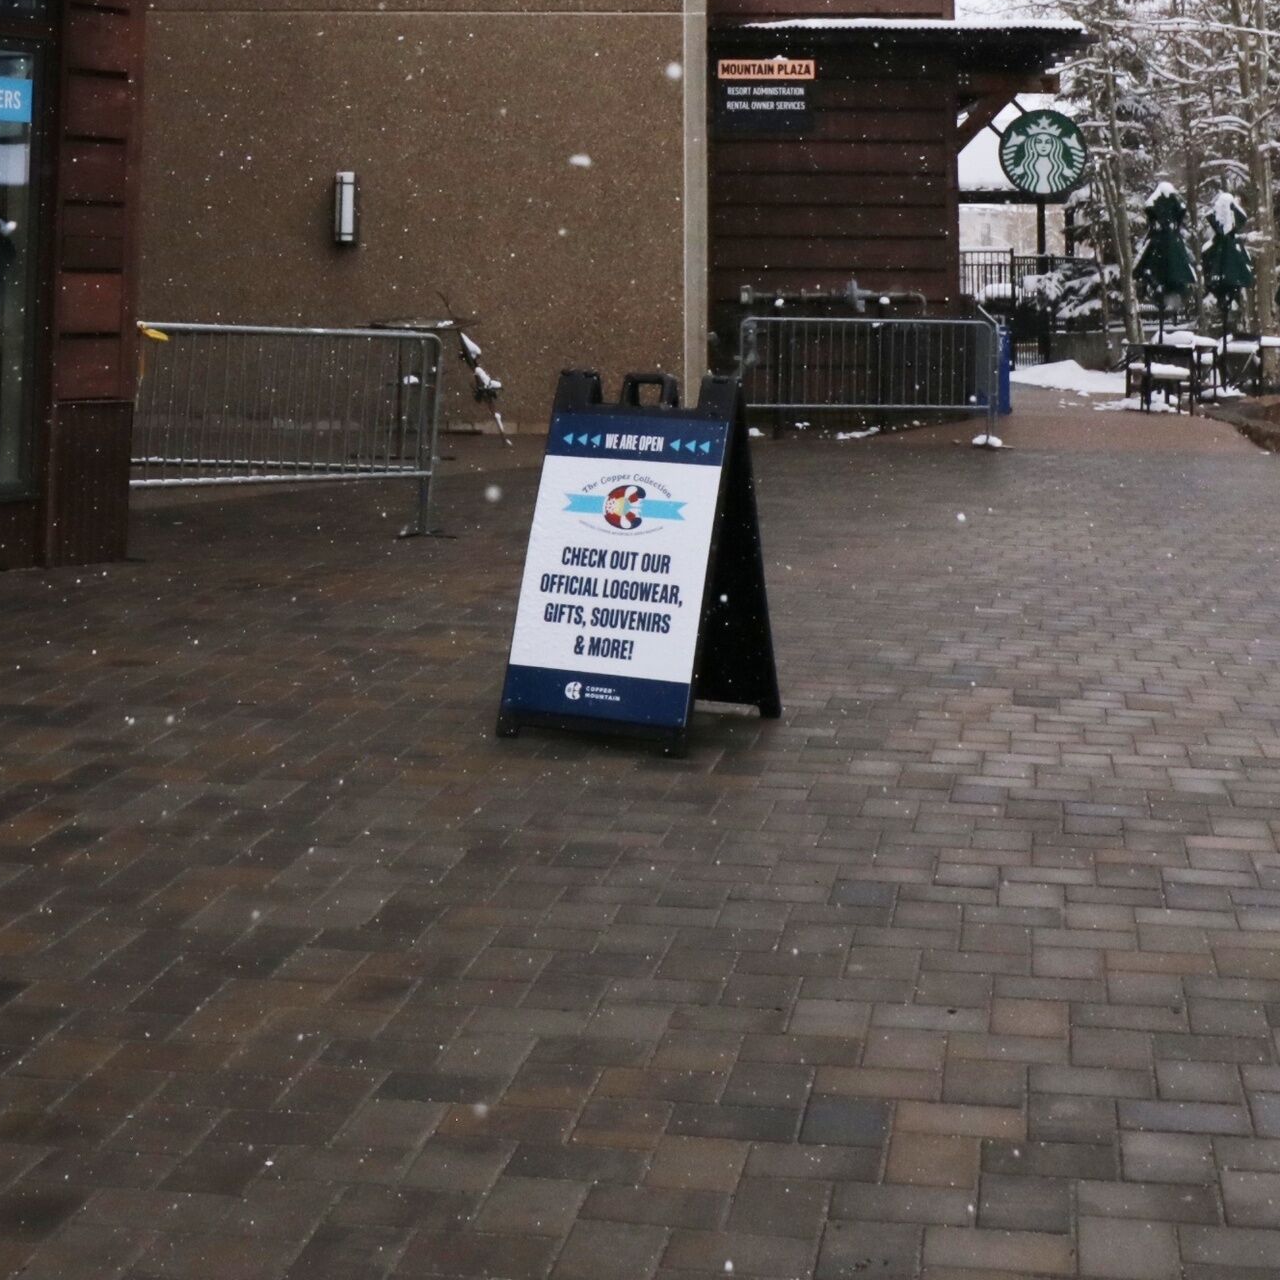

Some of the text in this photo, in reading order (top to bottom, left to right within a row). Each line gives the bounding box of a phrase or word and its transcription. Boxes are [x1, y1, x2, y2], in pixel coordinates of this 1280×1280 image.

[721, 63, 812, 76] MOUNTAIN PLAZA
[727, 86, 805, 96] RESORT ADMINISTRATION
[726, 101, 806, 111] RENTAL OWNER SERVICES
[605, 433, 665, 452] WE ARE OPEN
[581, 473, 673, 499] The Copper Collection
[561, 546, 671, 574] CHECK OUT OUR
[540, 573, 683, 608] OFFICIAL LOGOWEAR,
[543, 602, 672, 634] GIFTS, SOUVENIRS
[573, 634, 634, 660] & MORE!
